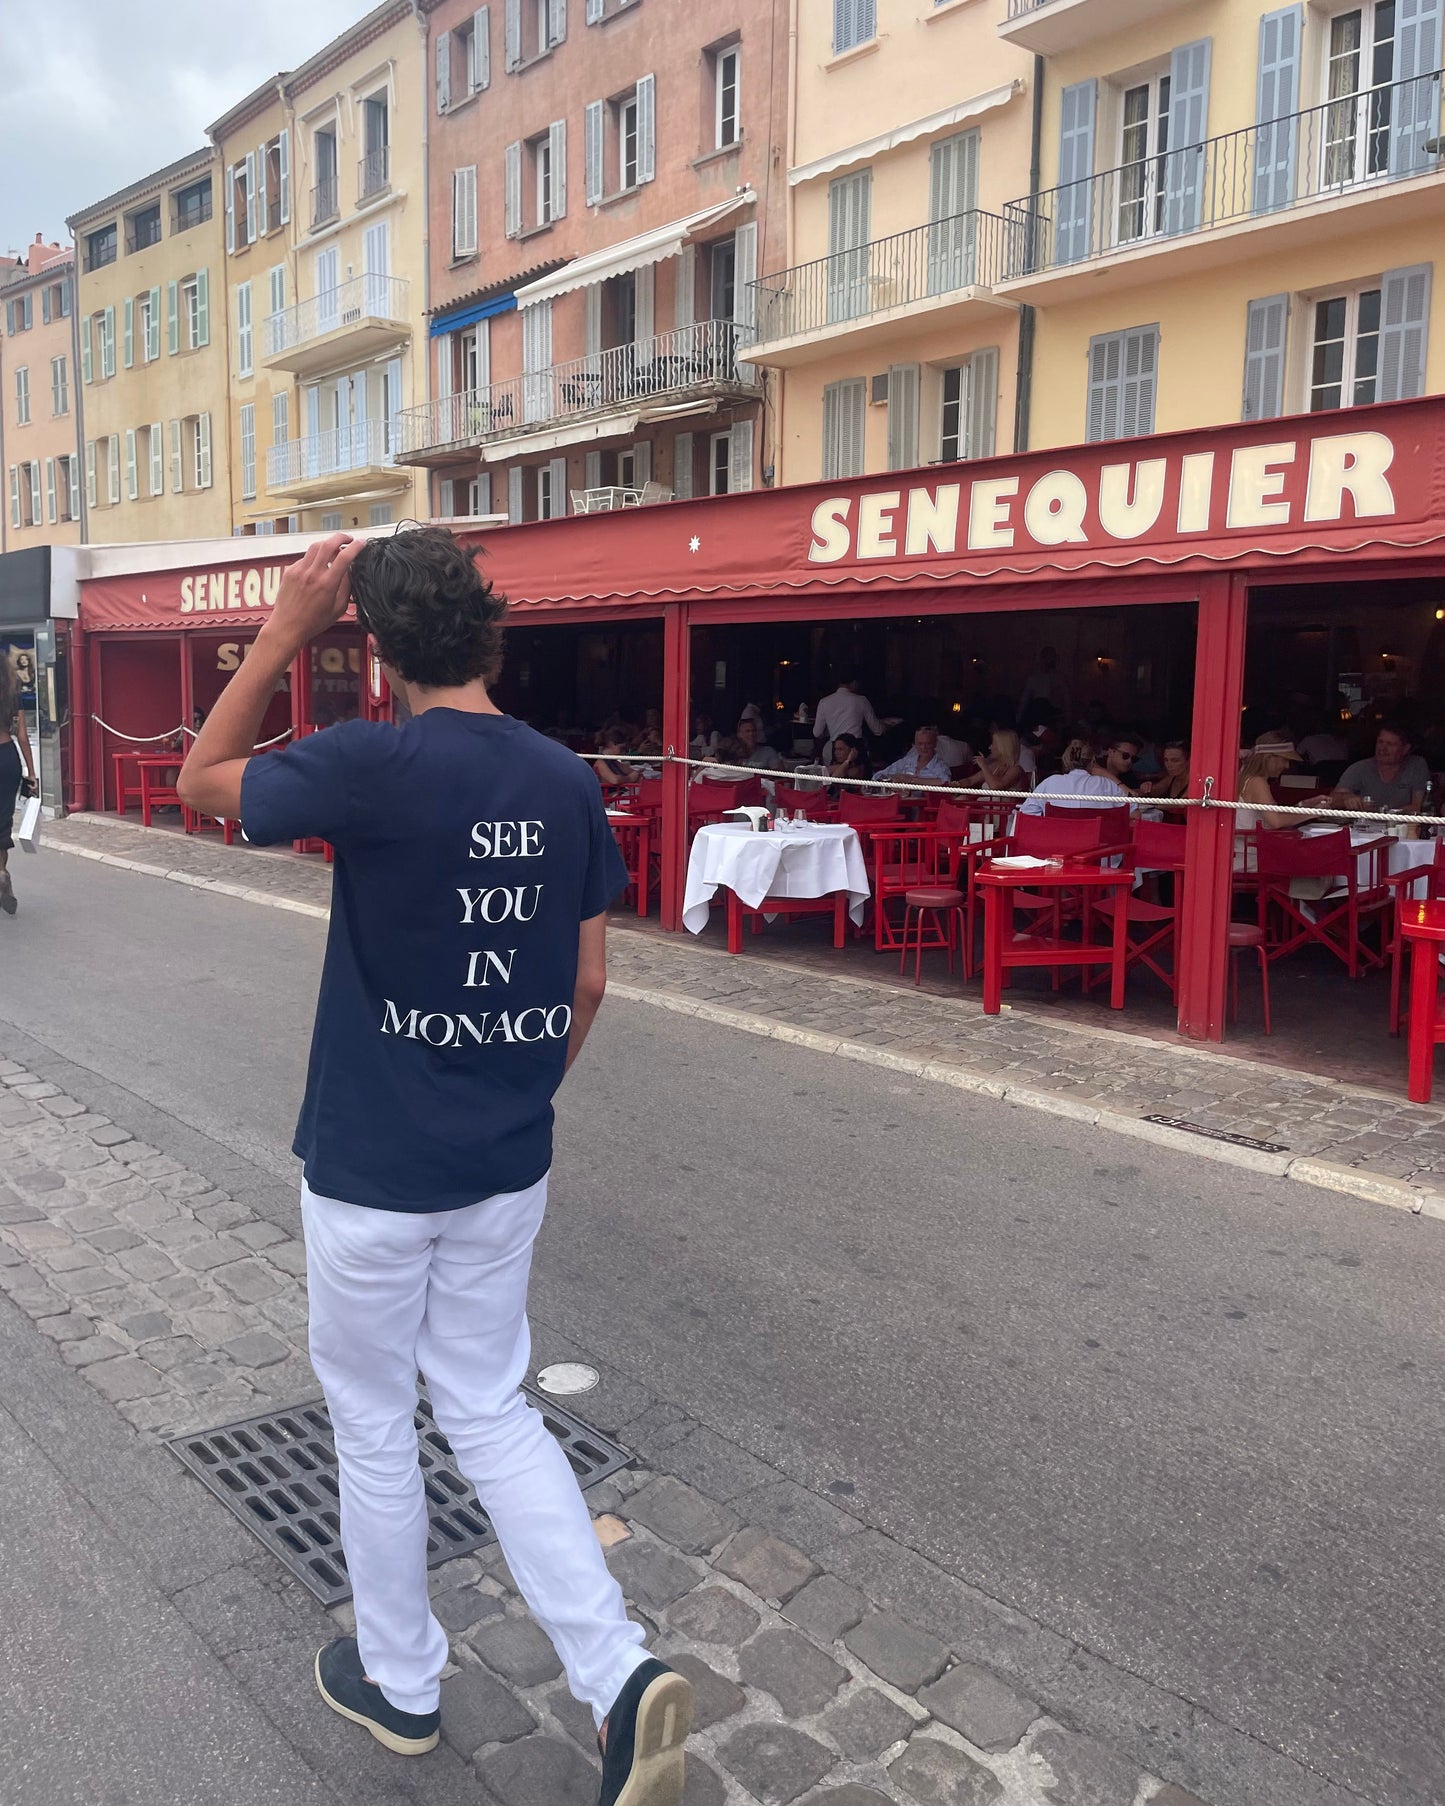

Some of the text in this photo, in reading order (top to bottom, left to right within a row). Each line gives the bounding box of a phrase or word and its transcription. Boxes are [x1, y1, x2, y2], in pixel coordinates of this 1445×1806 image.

[807, 431, 1395, 563] SENEQUIER
[180, 565, 291, 613] SENEQU
[469, 820, 545, 858] SEE
[456, 884, 544, 924] YOU
[462, 948, 518, 987] IN
[379, 998, 572, 1048] MONACO
